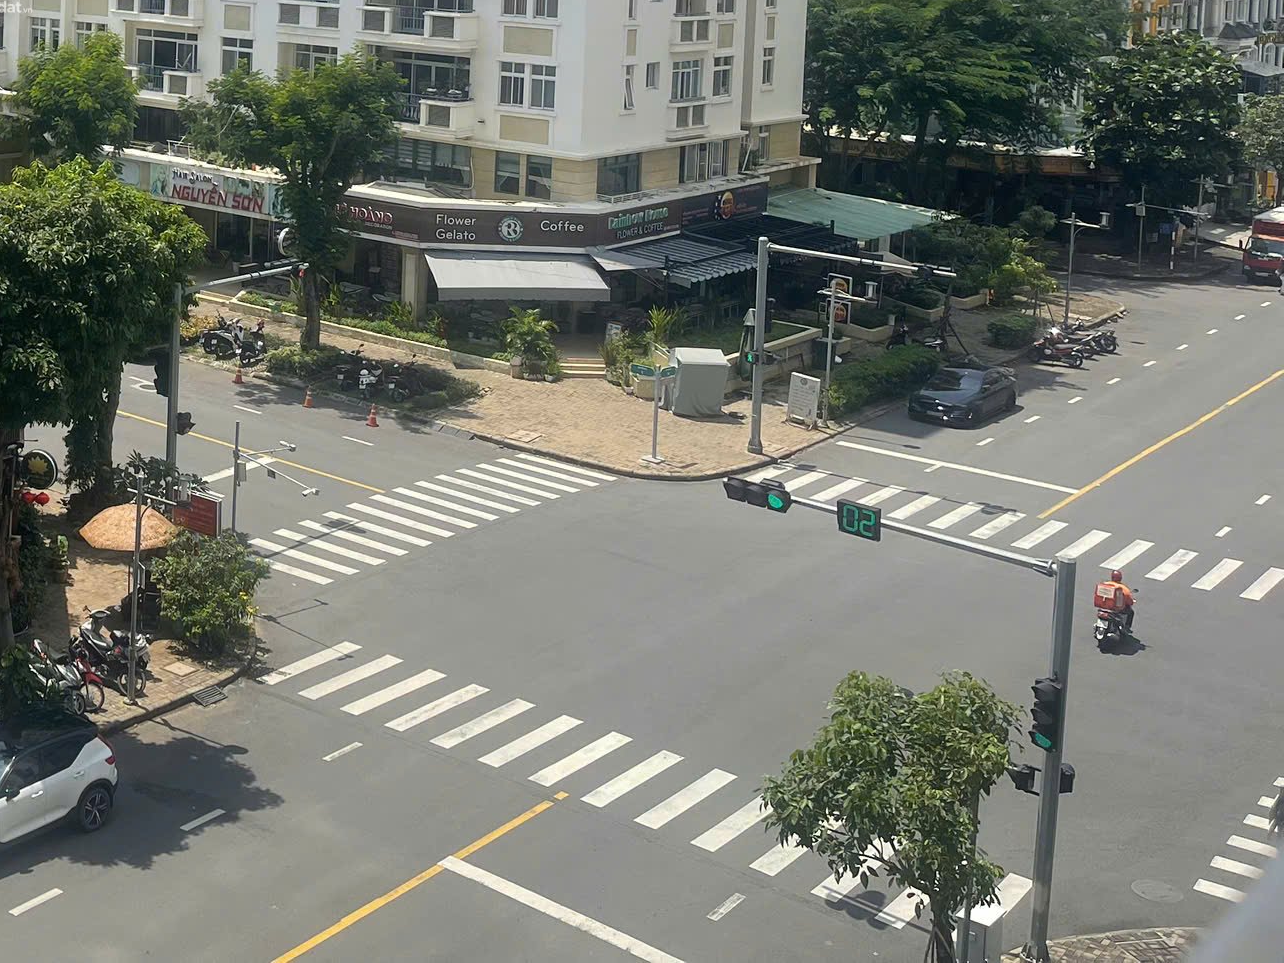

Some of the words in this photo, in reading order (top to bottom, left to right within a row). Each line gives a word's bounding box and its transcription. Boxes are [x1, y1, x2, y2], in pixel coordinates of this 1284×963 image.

[232, 194, 265, 213] SƠN
[436, 214, 476, 226] Flower
[540, 220, 584, 232] Coffee
[436, 229, 476, 241] Gelato
[843, 505, 876, 537] 02
